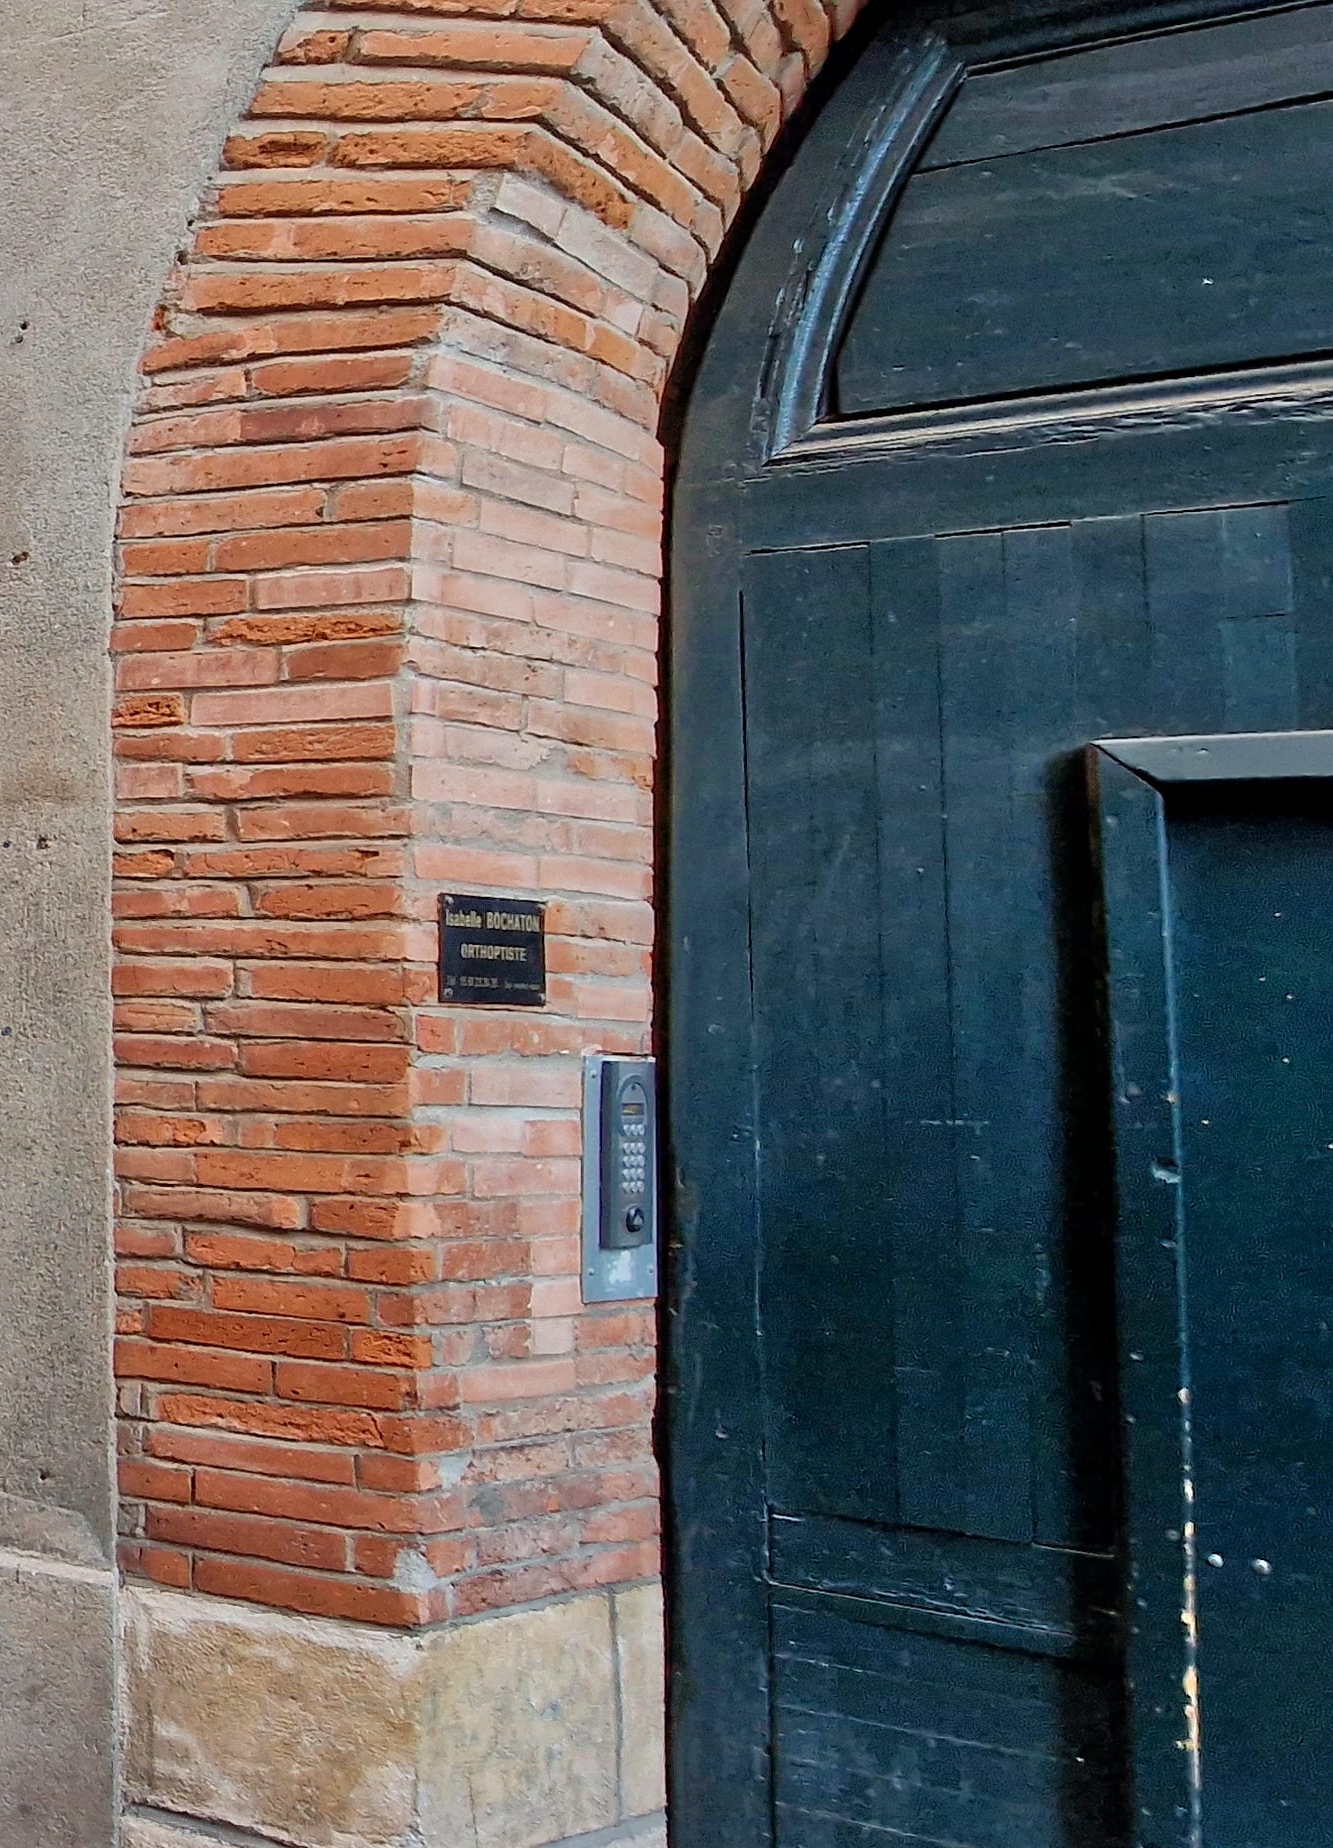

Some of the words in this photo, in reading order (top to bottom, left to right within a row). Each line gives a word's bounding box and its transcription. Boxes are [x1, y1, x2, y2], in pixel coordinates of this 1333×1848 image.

[445, 908, 482, 929] Isabelle
[486, 911, 540, 932] BOCHATON
[460, 943, 527, 962] ORTHOPTISTE
